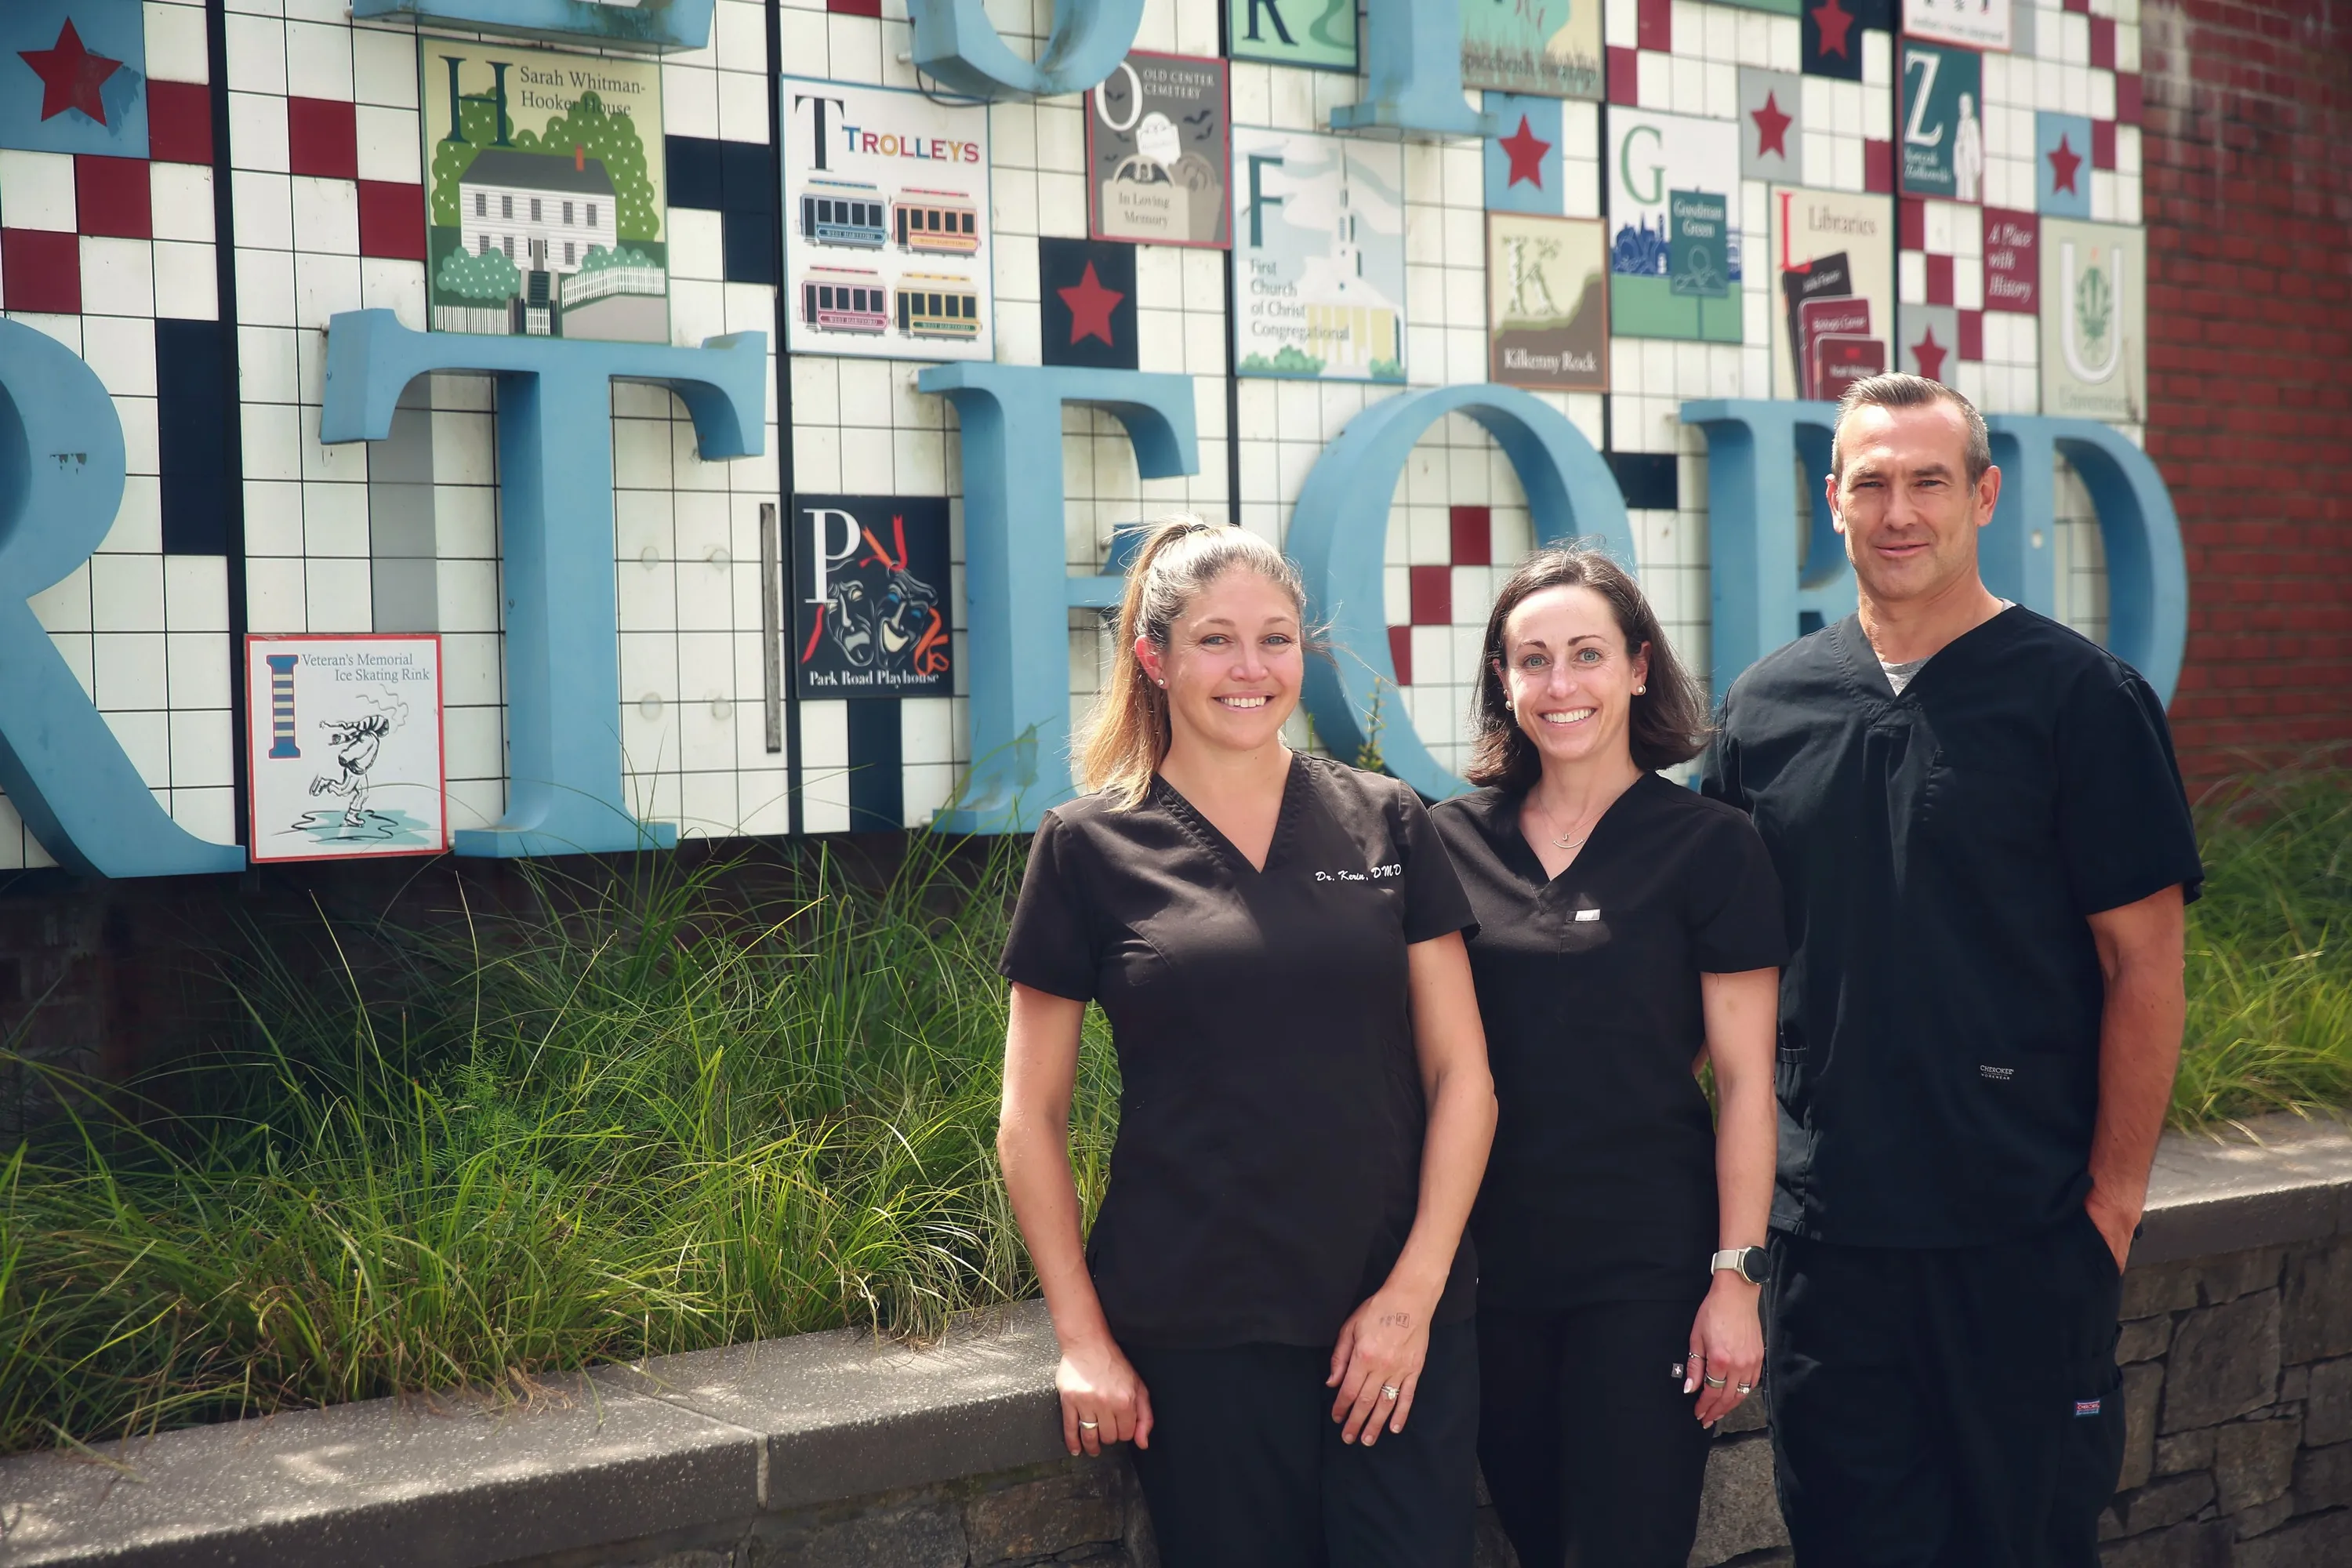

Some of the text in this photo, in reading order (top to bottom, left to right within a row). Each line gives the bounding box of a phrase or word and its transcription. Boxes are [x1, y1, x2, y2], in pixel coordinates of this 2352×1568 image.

[520, 66, 647, 95] Sarah Whitman-
[1142, 67, 1215, 88] OLD CENTER
[437, 54, 517, 148] H
[521, 90, 632, 117] Hooker House
[1094, 60, 1143, 132] O
[1142, 83, 1202, 100] CEMETERY
[1904, 49, 1944, 147] Z
[794, 93, 846, 172] T
[841, 125, 981, 164] TROLLEYS
[1619, 124, 1667, 206] G
[1118, 192, 1171, 210] In Loving
[1248, 154, 1284, 249] F
[1123, 209, 1170, 227] Memory
[1807, 205, 1878, 237] Libraries
[1776, 191, 1813, 274] L
[1987, 222, 2034, 249] A Place
[1250, 258, 1278, 276] First
[1987, 249, 2016, 270] with
[1250, 278, 1298, 298] Church
[1988, 273, 2034, 304] History
[1250, 301, 1307, 318] of Christ
[2061, 240, 2122, 383] U
[1251, 321, 1350, 343] Congregational
[1504, 347, 1597, 375] Kilkenny Rock
[802, 508, 862, 604] P
[302, 652, 413, 666] Veteran's Memorial
[335, 668, 430, 684] Ice Skating Rink
[808, 669, 940, 689] Park Road Playhouse
[266, 654, 301, 760] I
[1315, 870, 1335, 881] Dr.
[1370, 863, 1402, 879] DMD
